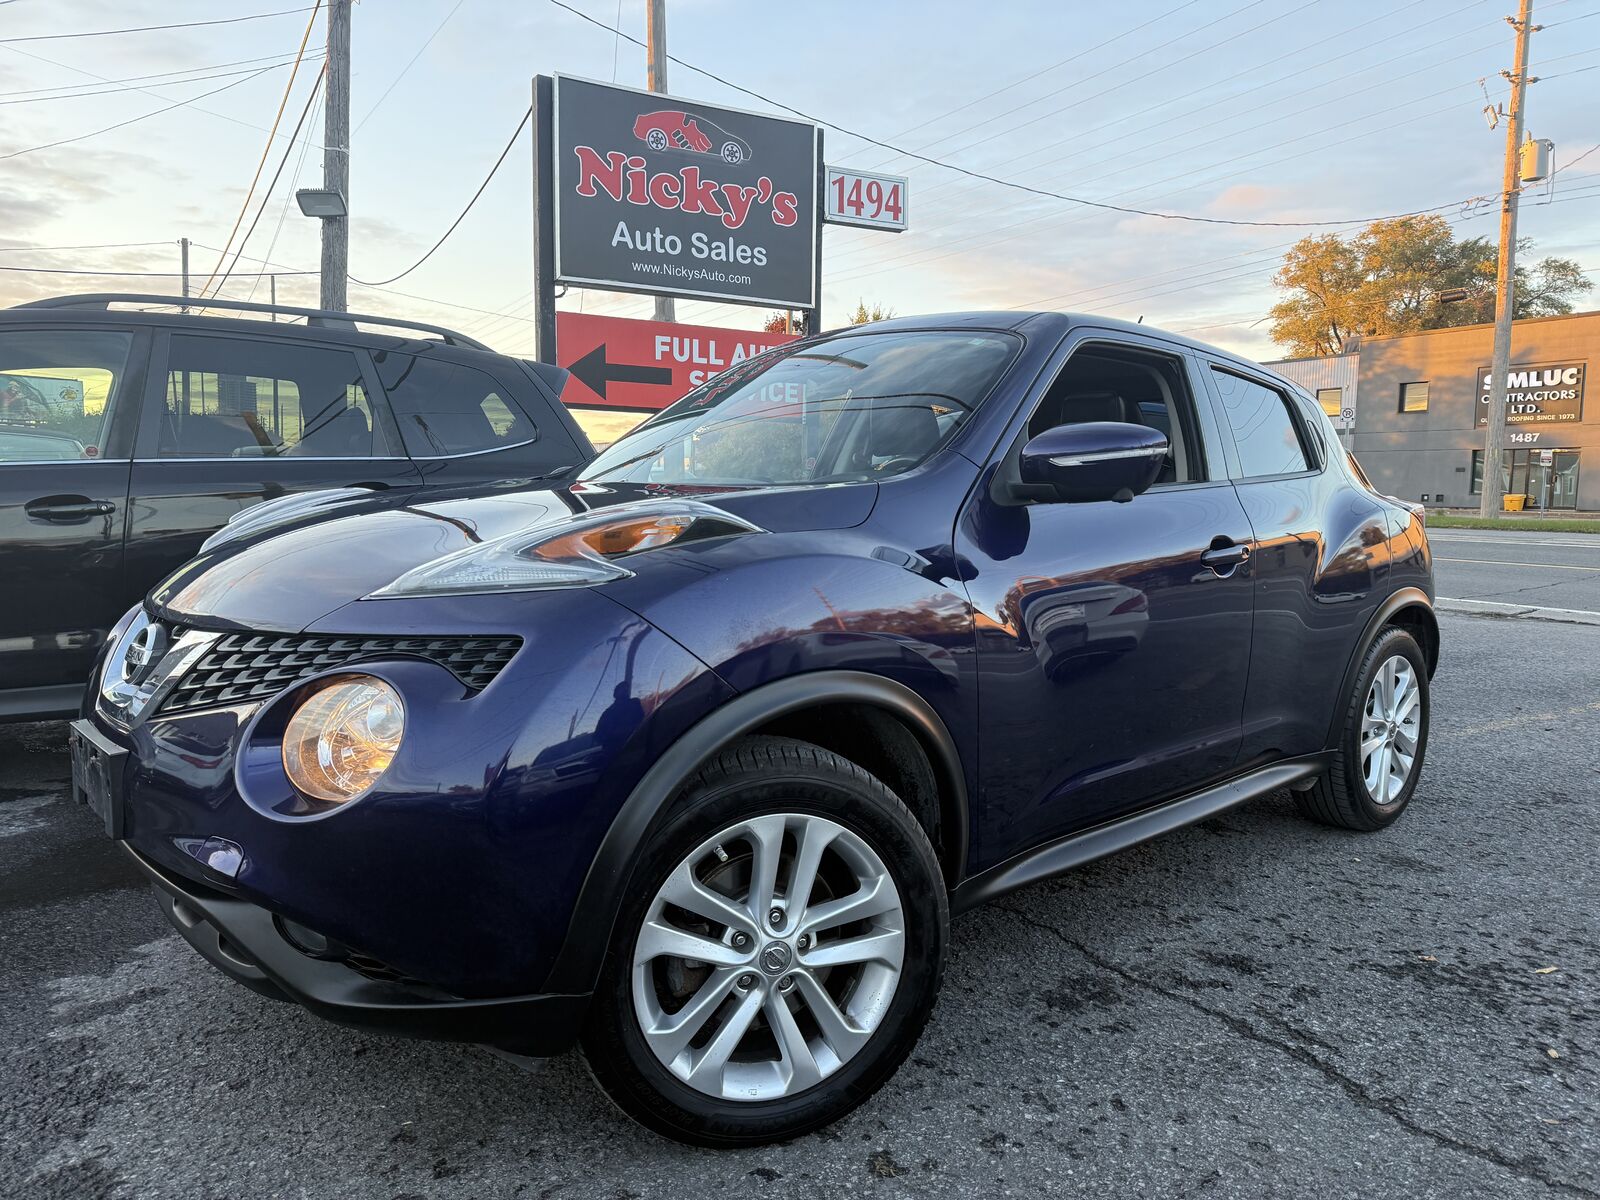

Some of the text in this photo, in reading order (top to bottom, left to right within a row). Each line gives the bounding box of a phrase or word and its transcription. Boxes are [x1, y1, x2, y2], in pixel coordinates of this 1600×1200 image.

[574, 145, 798, 229] Nicky's
[831, 175, 902, 222] 1494
[612, 221, 768, 266] Auto Sales
[632, 261, 751, 285] www.NickysAuto.com
[654, 335, 725, 366] FULL
[1483, 367, 1578, 390] SMLUC
[1481, 389, 1576, 404] CTRACTORS
[1511, 404, 1541, 414] LTD.
[1510, 433, 1540, 443] 1487
